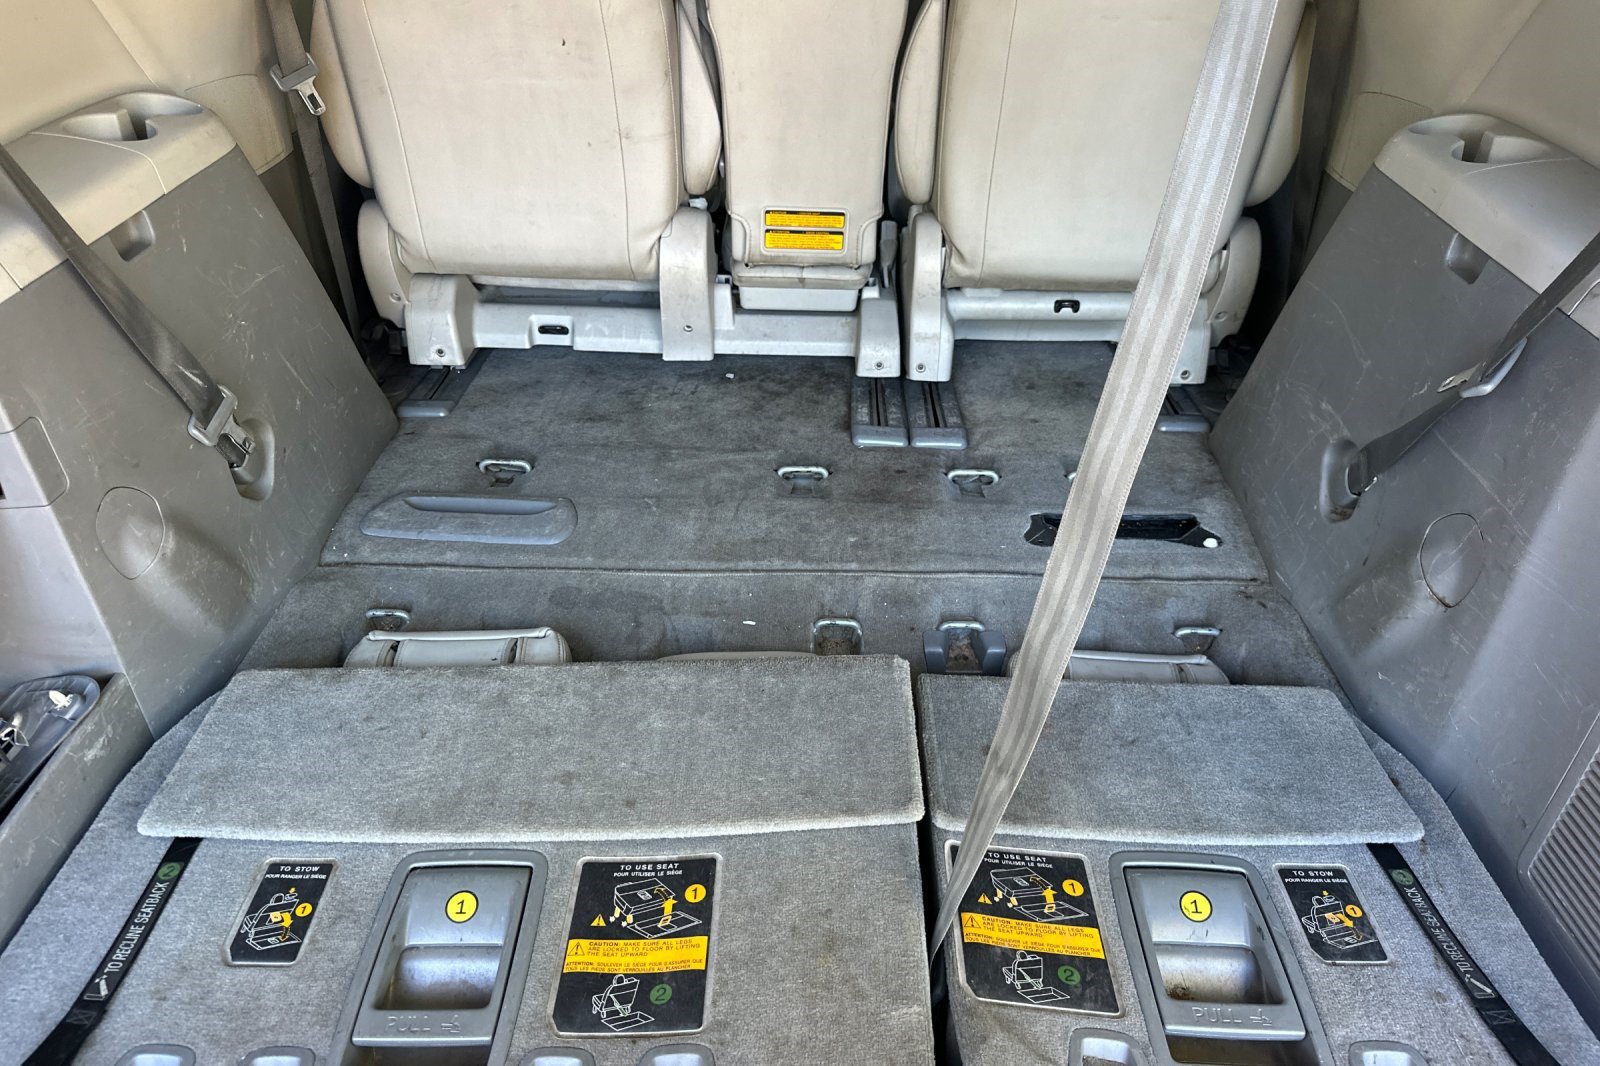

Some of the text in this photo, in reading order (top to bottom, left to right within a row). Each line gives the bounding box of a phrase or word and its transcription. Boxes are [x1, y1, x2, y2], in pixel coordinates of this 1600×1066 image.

[691, 888, 700, 900] 1
[1068, 882, 1076, 893] 1
[301, 906, 307, 914] 1
[455, 899, 467, 915] 1
[1190, 899, 1202, 914] 1
[1404, 887, 1440, 927] SEATBACK
[104, 882, 169, 973] TO RECLINE SEATBACK
[1432, 928, 1464, 960] RECLINE
[1064, 968, 1076, 981] 2
[654, 987, 667, 1001] 2
[1192, 1006, 1242, 1023] PULL
[385, 1016, 431, 1032] PULL
